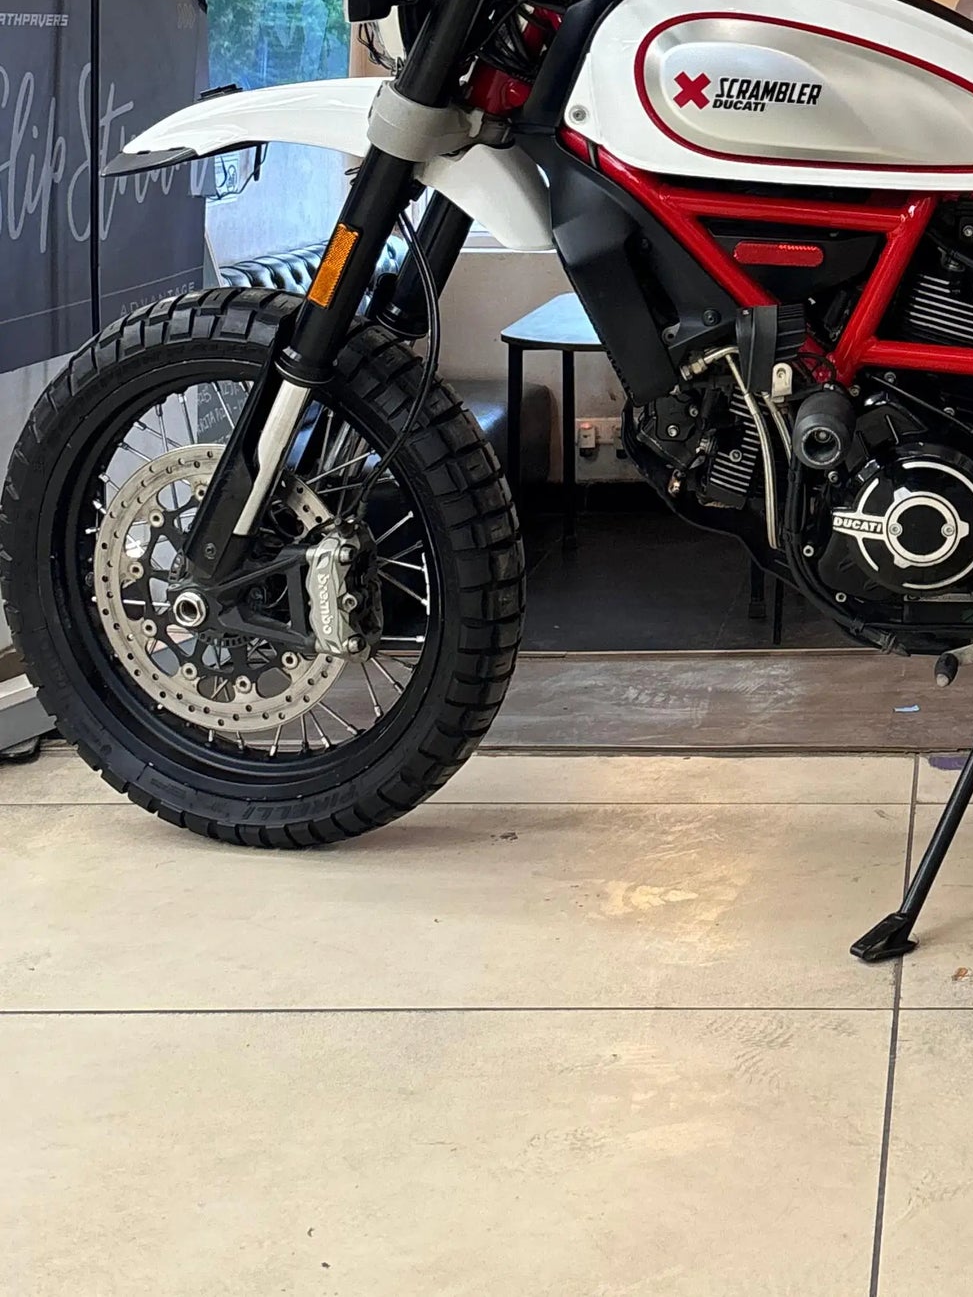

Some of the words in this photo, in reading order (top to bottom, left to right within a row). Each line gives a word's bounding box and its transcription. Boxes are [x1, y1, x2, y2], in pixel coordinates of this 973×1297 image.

[715, 77, 822, 105] SCRAMBLER
[712, 98, 767, 113] DUCATI
[833, 516, 882, 534] DUCATI
[317, 573, 334, 636] brembo
